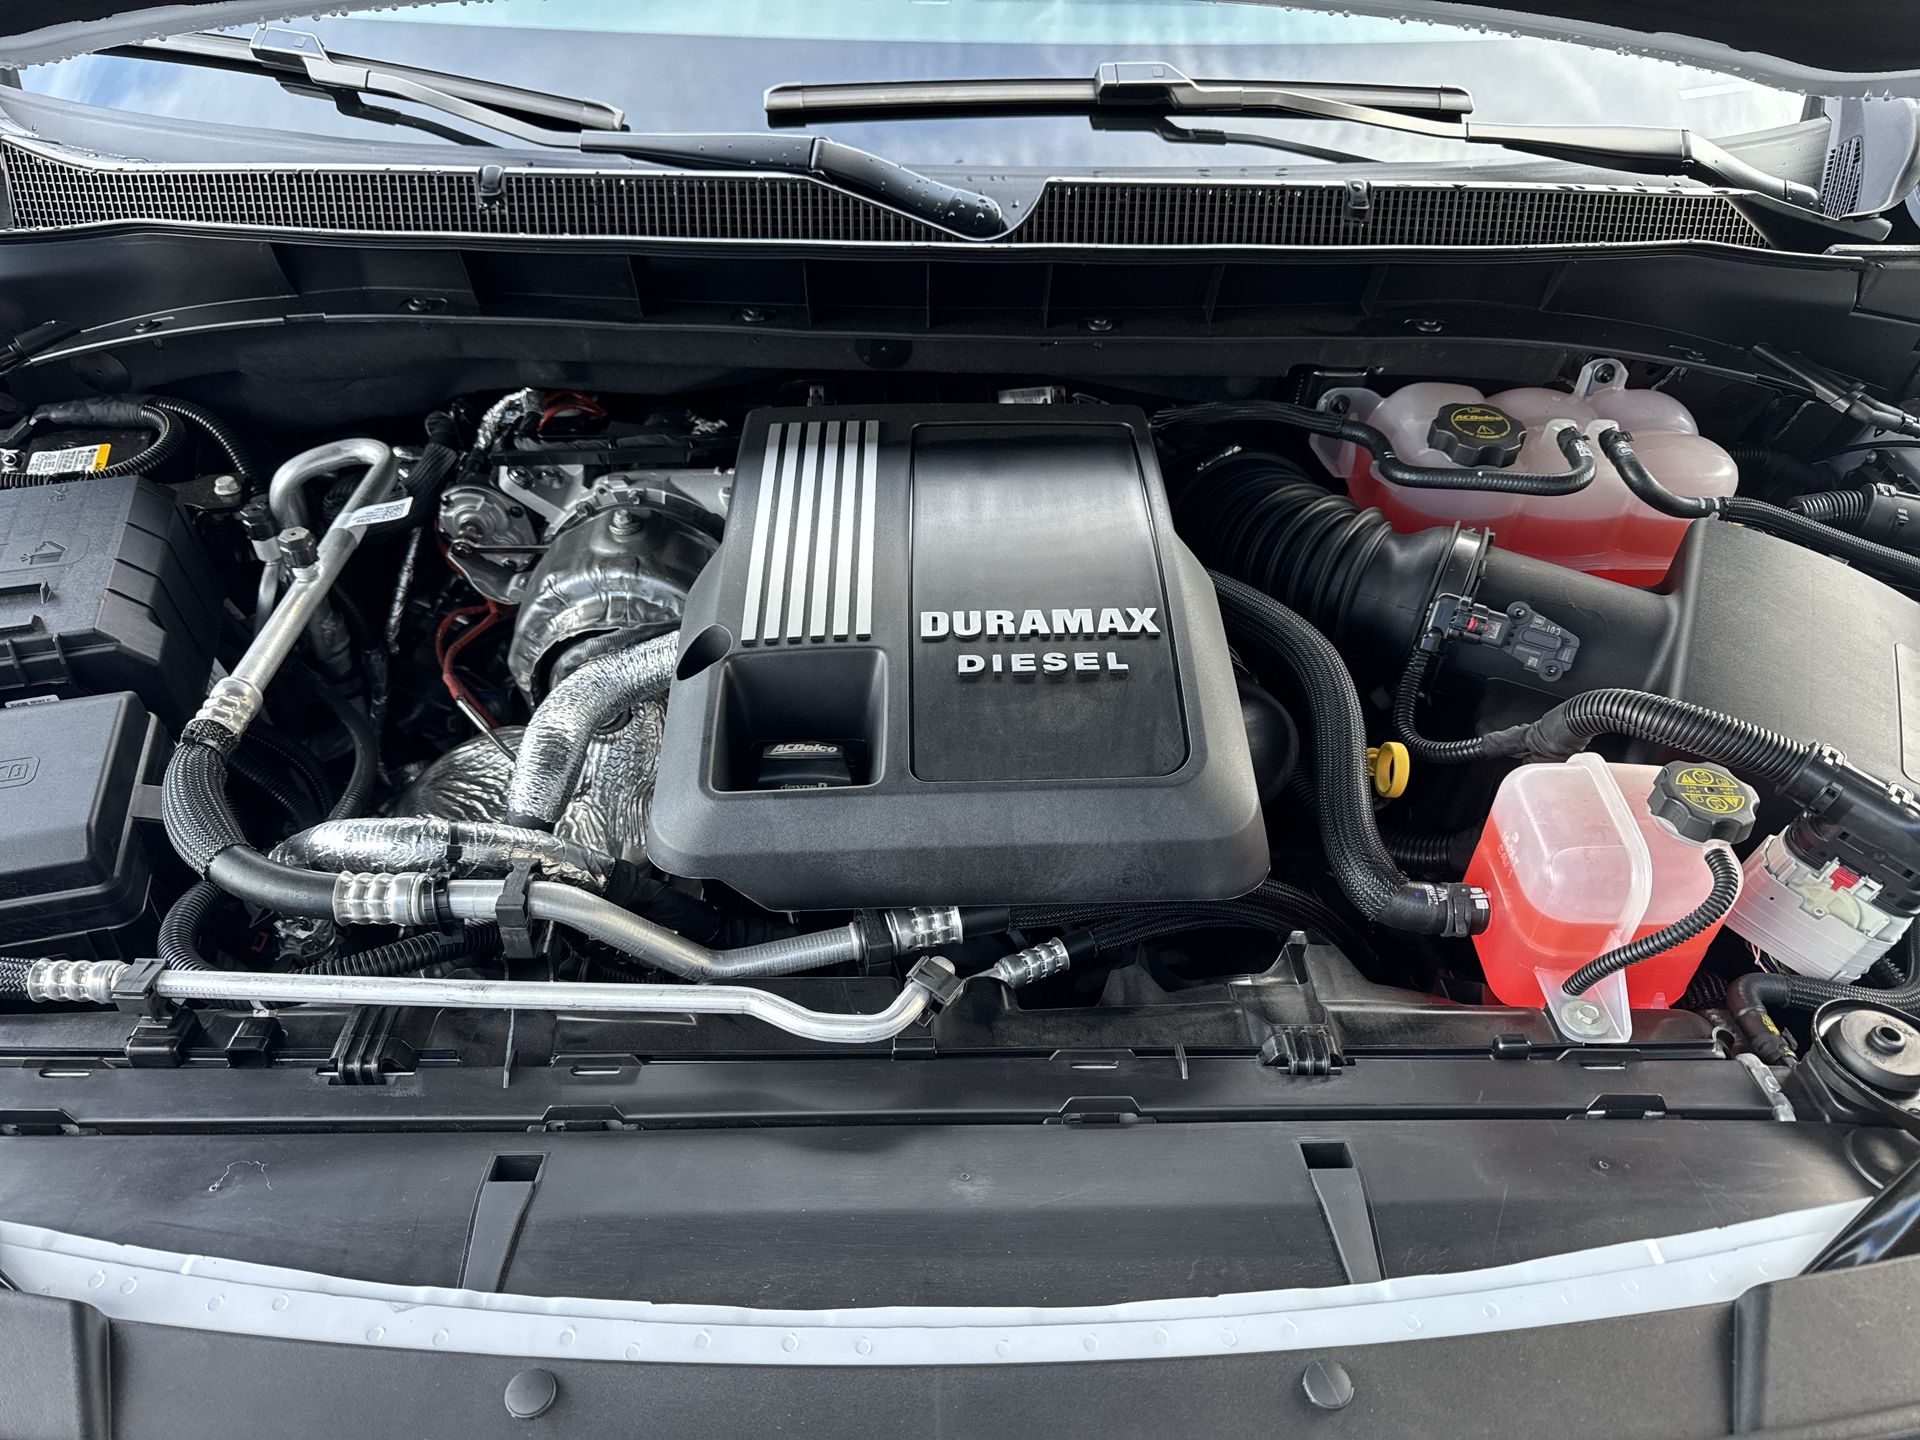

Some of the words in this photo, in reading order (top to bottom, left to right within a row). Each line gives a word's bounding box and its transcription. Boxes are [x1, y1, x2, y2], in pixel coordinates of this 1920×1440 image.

[920, 608, 1161, 641] DURAMAX
[957, 652, 1130, 677] DIESEL
[769, 744, 838, 754] ACDelco
